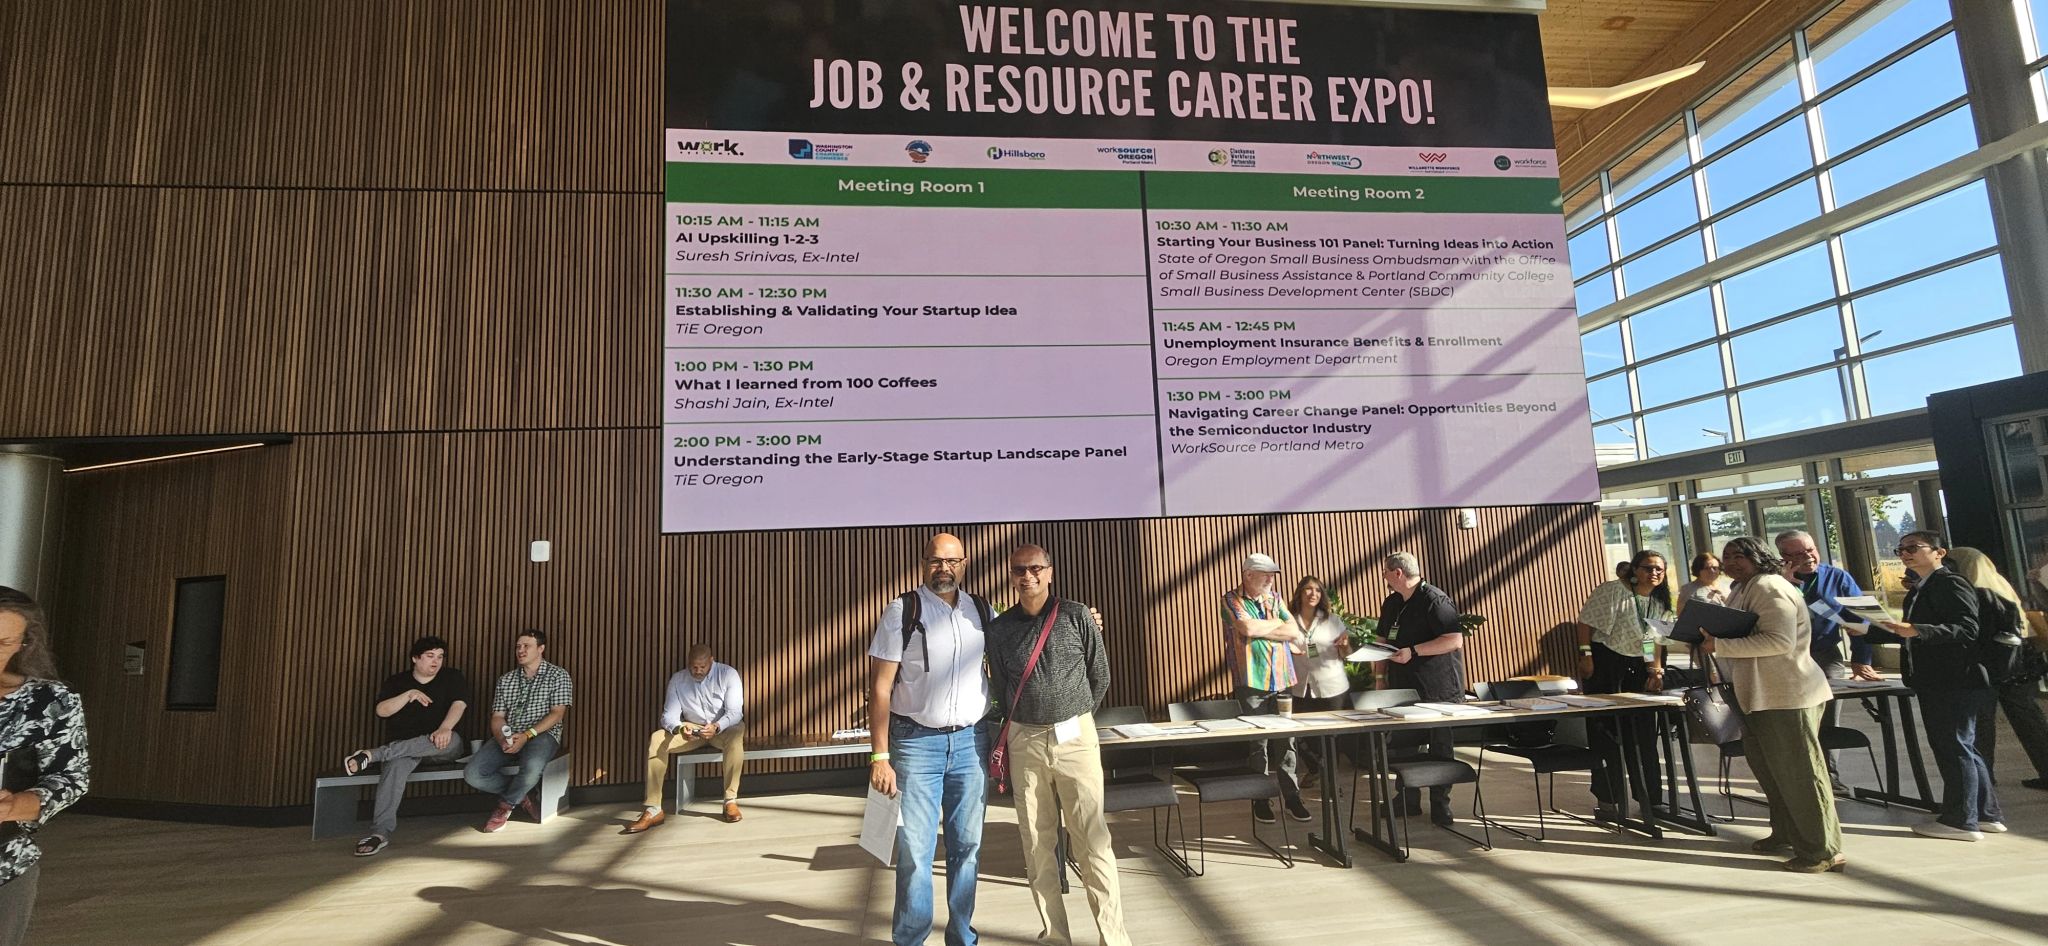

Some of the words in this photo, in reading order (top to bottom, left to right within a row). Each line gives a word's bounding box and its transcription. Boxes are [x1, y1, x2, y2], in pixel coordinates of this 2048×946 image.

[959, 6, 1157, 58] WELCOME
[1166, 14, 1216, 61] TO
[1226, 16, 1301, 64] THE
[809, 59, 884, 109] JOB
[899, 61, 931, 111] &
[945, 64, 1156, 116] RESOURCE
[1168, 71, 1317, 121] CAREER
[1327, 77, 1436, 124] EXPO!
[1003, 149, 1046, 158] Hillsboro
[838, 179, 914, 195] Meeting
[920, 180, 973, 193] Room
[977, 181, 985, 193] 1
[1293, 186, 1360, 201] Meeting
[1364, 187, 1412, 199] Room
[1415, 188, 1425, 200] 2
[675, 215, 713, 226] 10:15
[716, 216, 743, 226] AM
[758, 216, 790, 227] 11:15
[793, 217, 820, 228] AM
[1155, 220, 1192, 231] 10:30
[1195, 221, 1219, 231] AM
[1230, 221, 1263, 232] 11:30
[1265, 222, 1289, 232] AM
[675, 232, 693, 243] AI
[698, 232, 779, 247] Upskilling
[783, 234, 819, 245] 1-2-3
[1156, 236, 1215, 249] Starting
[1218, 237, 1252, 247] Your
[1255, 237, 1317, 248] Business
[1319, 238, 1339, 248] 101
[1342, 238, 1385, 249] Panel:
[1386, 238, 1440, 251] Turning
[1443, 239, 1480, 249] Ideas
[1481, 238, 1509, 249] into
[1511, 239, 1554, 249] Action
[675, 250, 730, 262] Suresh
[733, 251, 798, 264] Srinivas,
[802, 251, 860, 263] Ex-Intel
[1157, 253, 1195, 264] State
[1198, 253, 1214, 264] of
[1215, 253, 1266, 266] Oregon
[1269, 254, 1309, 265] Small
[1311, 254, 1370, 265] Business
[1372, 254, 1460, 265] Ombudsman
[1461, 254, 1493, 266] with
[1494, 254, 1515, 266] the
[1518, 254, 1557, 266] Office
[1159, 269, 1175, 281] of
[1176, 269, 1216, 280] Small
[1219, 270, 1279, 281] Business
[1281, 270, 1353, 281] Assistance
[1356, 270, 1366, 281] &
[1368, 270, 1426, 281] Portland
[1428, 270, 1505, 283] Community
[1507, 270, 1555, 283] College
[675, 287, 712, 298] 11:30
[716, 287, 743, 298] AM
[758, 288, 798, 298] 12:30
[802, 288, 827, 299] PM
[1160, 286, 1201, 297] Small
[1204, 286, 1265, 297] Business
[1268, 286, 1358, 300] Development
[1361, 286, 1406, 297] Center
[1409, 286, 1456, 299] (SBDC)
[675, 304, 777, 318] Establishing
[781, 305, 793, 316] &
[796, 304, 878, 318] Validating
[882, 305, 919, 316] Your
[922, 305, 981, 318] Startup
[985, 305, 1018, 316] Idea
[676, 323, 700, 335] TiE
[703, 323, 763, 337] Oregon
[1161, 321, 1195, 332] 11:45
[1198, 321, 1222, 332] AM
[1234, 321, 1270, 332] 12:45
[1273, 321, 1296, 331] PM
[1163, 338, 1277, 350] Unemployment
[1280, 338, 1349, 348] Insurance
[1353, 336, 1412, 347] Benefits
[1414, 336, 1425, 347] &
[1427, 336, 1504, 347] Enrollment
[674, 361, 707, 372] 1:00
[712, 361, 738, 372] PM
[752, 361, 784, 372] 1:30
[788, 360, 814, 371] PM
[1164, 355, 1218, 369] Oregon
[1221, 354, 1311, 368] Employment
[1314, 354, 1398, 366] Department
[674, 379, 722, 390] What
[726, 379, 731, 390] I
[735, 378, 798, 390] learned
[801, 377, 843, 389] from
[846, 377, 874, 389] 100
[877, 376, 938, 388] Coffees
[1166, 391, 1194, 402] 1:30
[1198, 390, 1221, 401] PM
[1234, 390, 1265, 401] 3:00
[1269, 389, 1291, 400] PM
[674, 397, 730, 410] Shashi
[732, 397, 770, 410] Jain,
[775, 396, 834, 408] Ex-Intel
[1168, 407, 1249, 421] Navigating
[1252, 407, 1300, 418] Career
[1303, 406, 1358, 418] Change
[1361, 404, 1405, 416] Panel:
[1407, 403, 1504, 417] Opportunities
[1506, 401, 1557, 415] Beyond
[1168, 425, 1195, 437] the
[1198, 424, 1309, 436] Semiconductor
[1312, 422, 1372, 435] Industry
[673, 436, 710, 448] 2:00
[715, 436, 741, 447] PM
[756, 435, 792, 446] 3:00
[796, 434, 822, 445] PM
[1171, 442, 1257, 454] WorkSource
[1260, 439, 1321, 452] Portland
[1324, 439, 1365, 450] Metro
[674, 453, 800, 467] Understanding
[804, 452, 833, 464] the
[837, 451, 930, 465] Early-Stage
[933, 450, 993, 462] Startup
[997, 448, 1081, 460] Landscape
[1084, 446, 1127, 458] Panel
[1728, 452, 1741, 463] EXIT
[674, 474, 699, 486] TiE
[702, 473, 764, 487] Oregon
